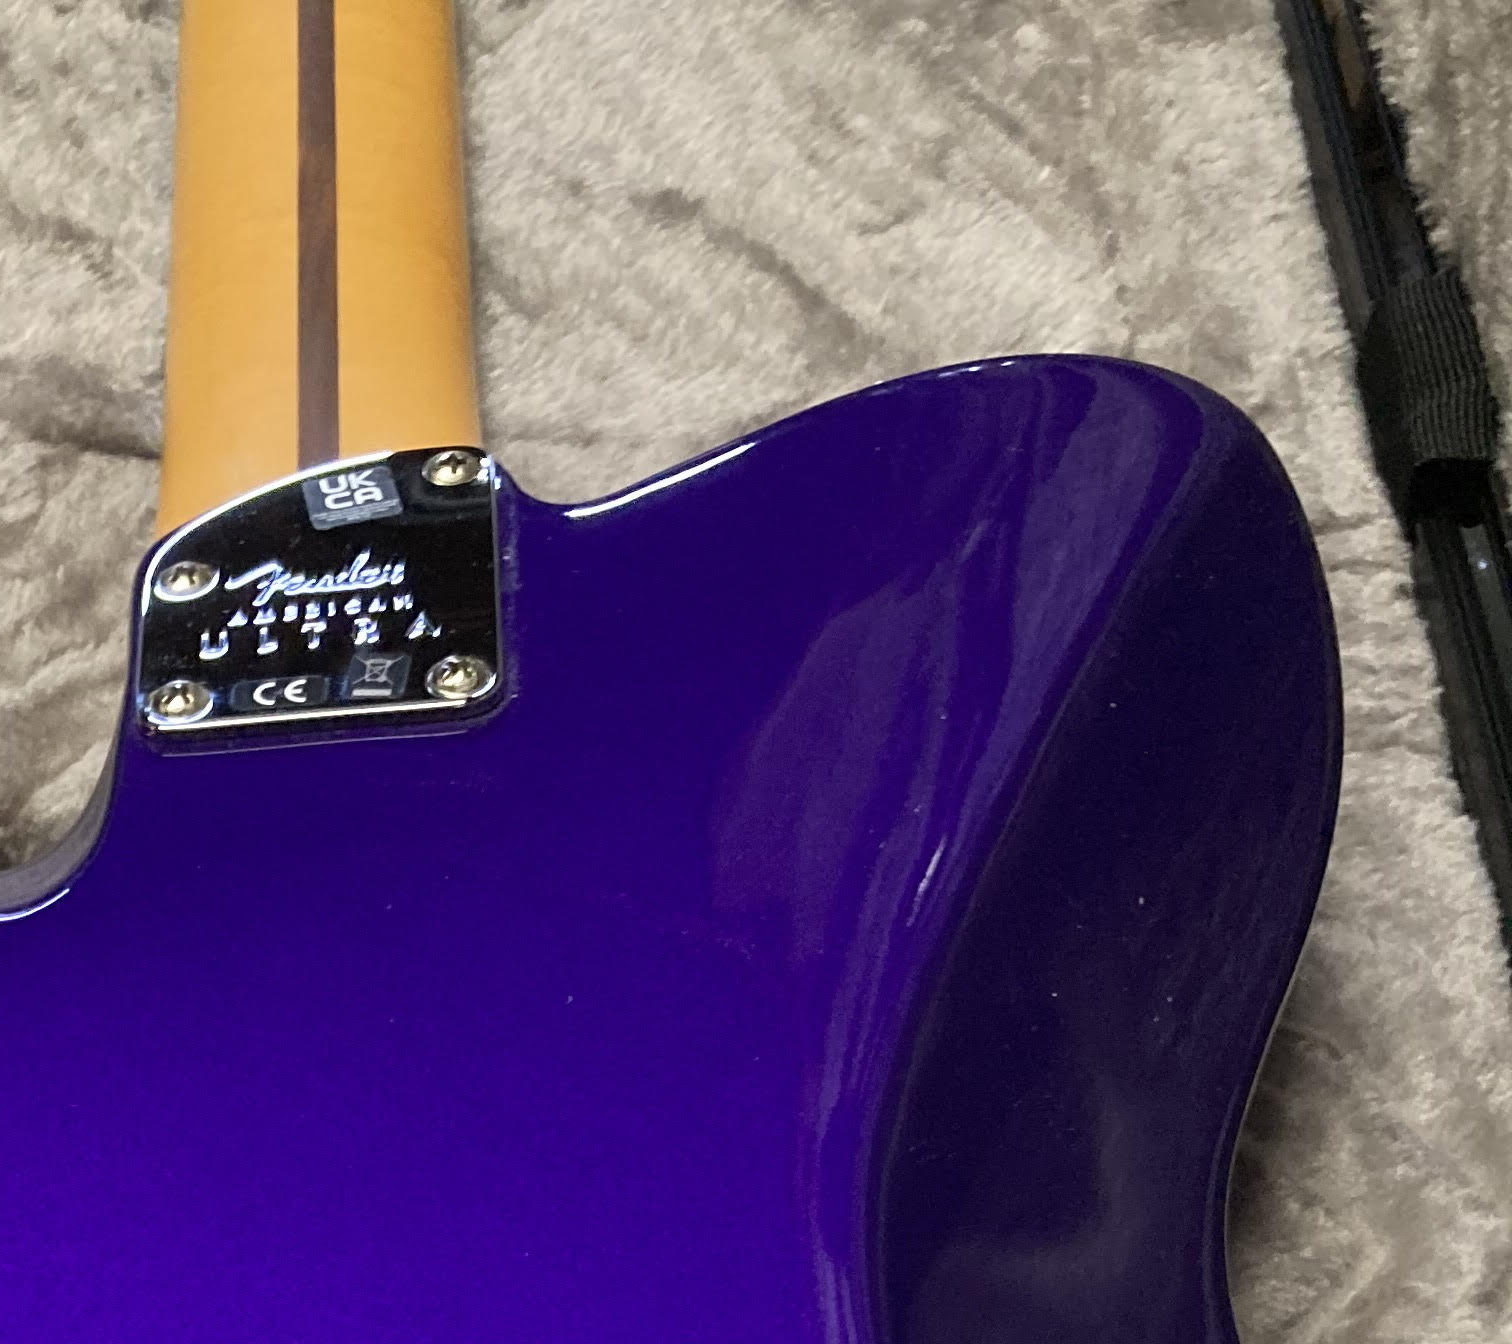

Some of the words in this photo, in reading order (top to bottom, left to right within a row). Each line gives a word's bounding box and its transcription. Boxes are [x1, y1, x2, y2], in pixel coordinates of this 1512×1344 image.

[318, 469, 376, 494] UK
[324, 486, 384, 509] CA
[225, 549, 405, 606] Fender
[227, 594, 413, 627] AMERICAN
[199, 611, 442, 661] ULTRA
[252, 679, 307, 706] CE
